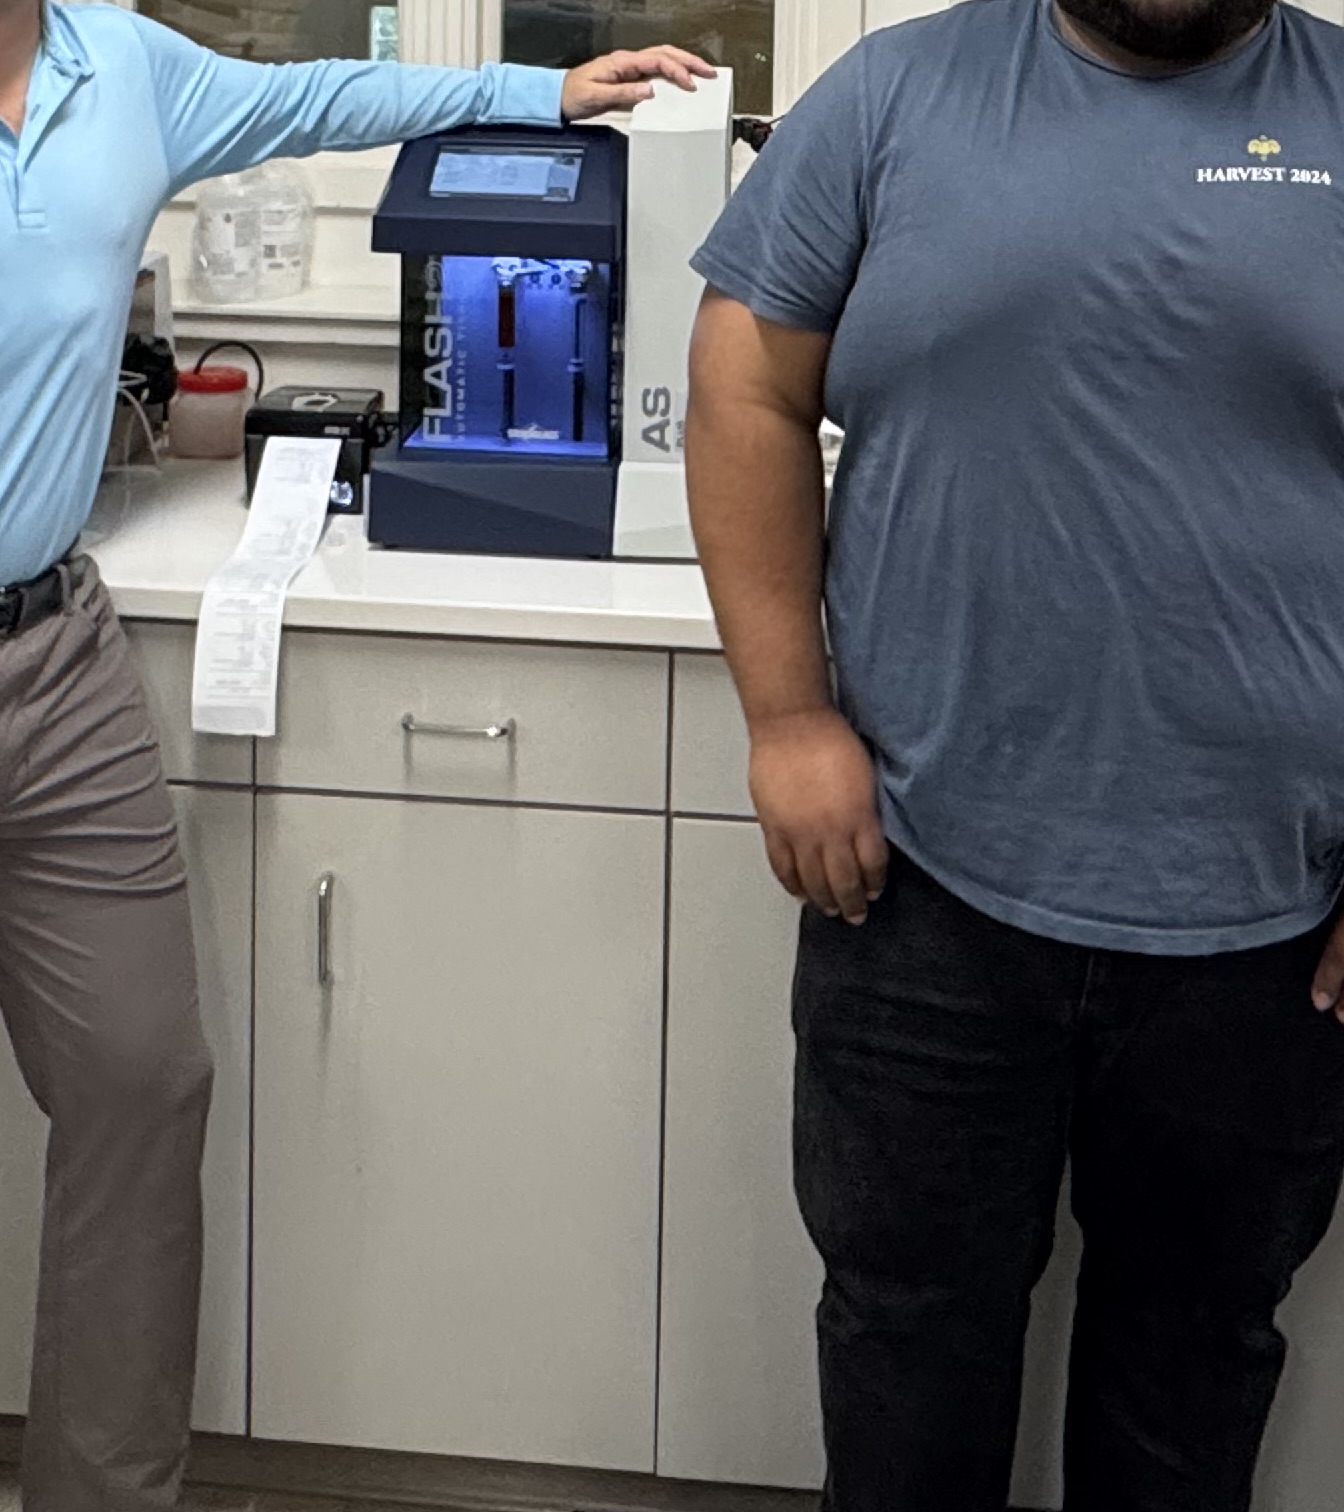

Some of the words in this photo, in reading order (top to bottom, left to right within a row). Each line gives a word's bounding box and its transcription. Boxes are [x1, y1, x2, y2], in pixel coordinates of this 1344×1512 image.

[1197, 167, 1285, 183] HARVEST
[1290, 168, 1332, 185] 2024
[422, 290, 454, 443] FLASH
[640, 385, 671, 454] AS
